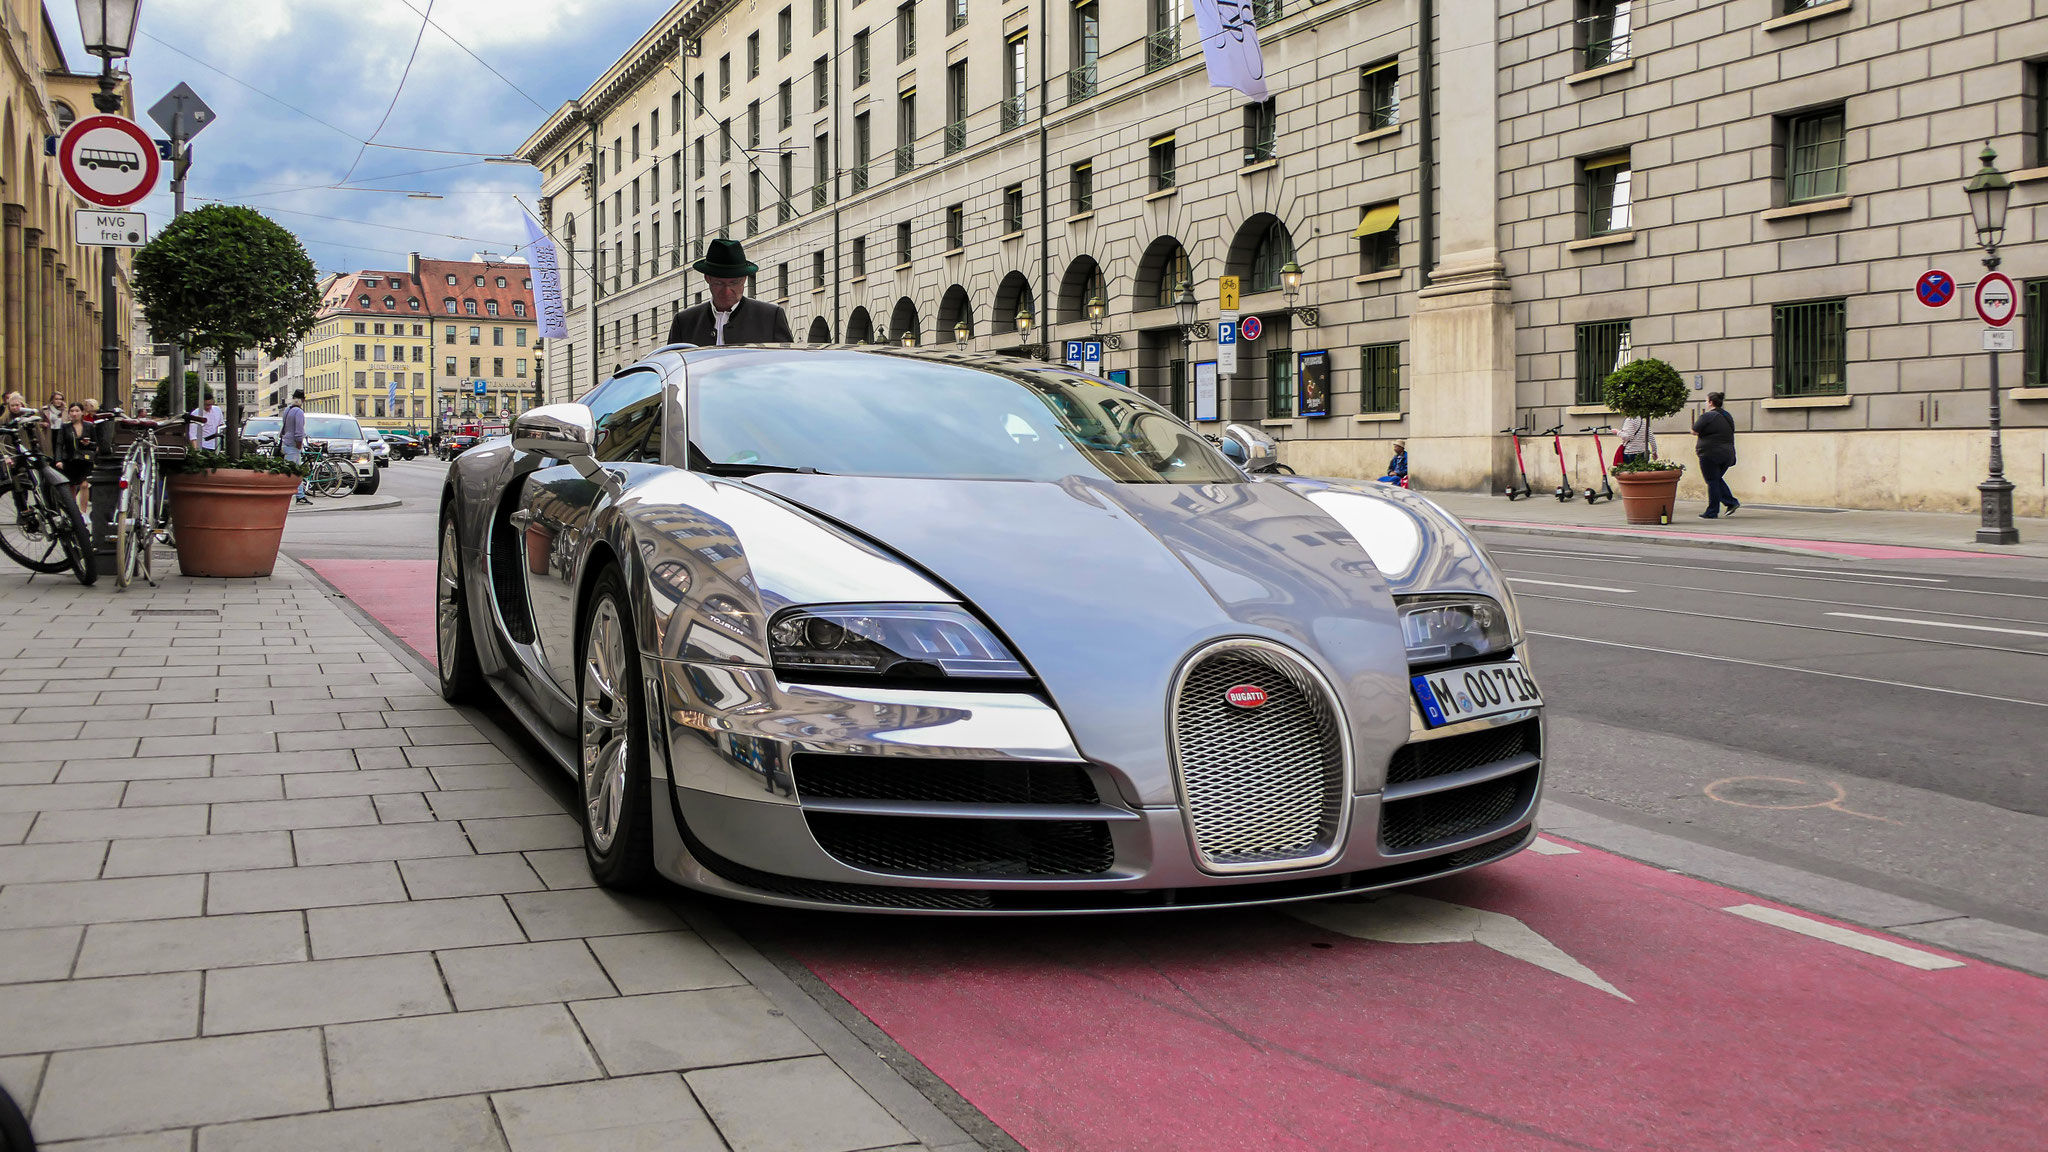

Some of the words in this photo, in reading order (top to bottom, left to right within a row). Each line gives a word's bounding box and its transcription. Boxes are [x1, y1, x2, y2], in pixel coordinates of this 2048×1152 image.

[97, 216, 125, 227] MVG
[101, 230, 122, 240] frei
[1220, 325, 1231, 342] P
[1069, 344, 1078, 359] P
[1086, 344, 1096, 360] P
[1230, 692, 1264, 702] BUGATTI
[1429, 677, 1460, 716] M
[1428, 706, 1438, 718] D
